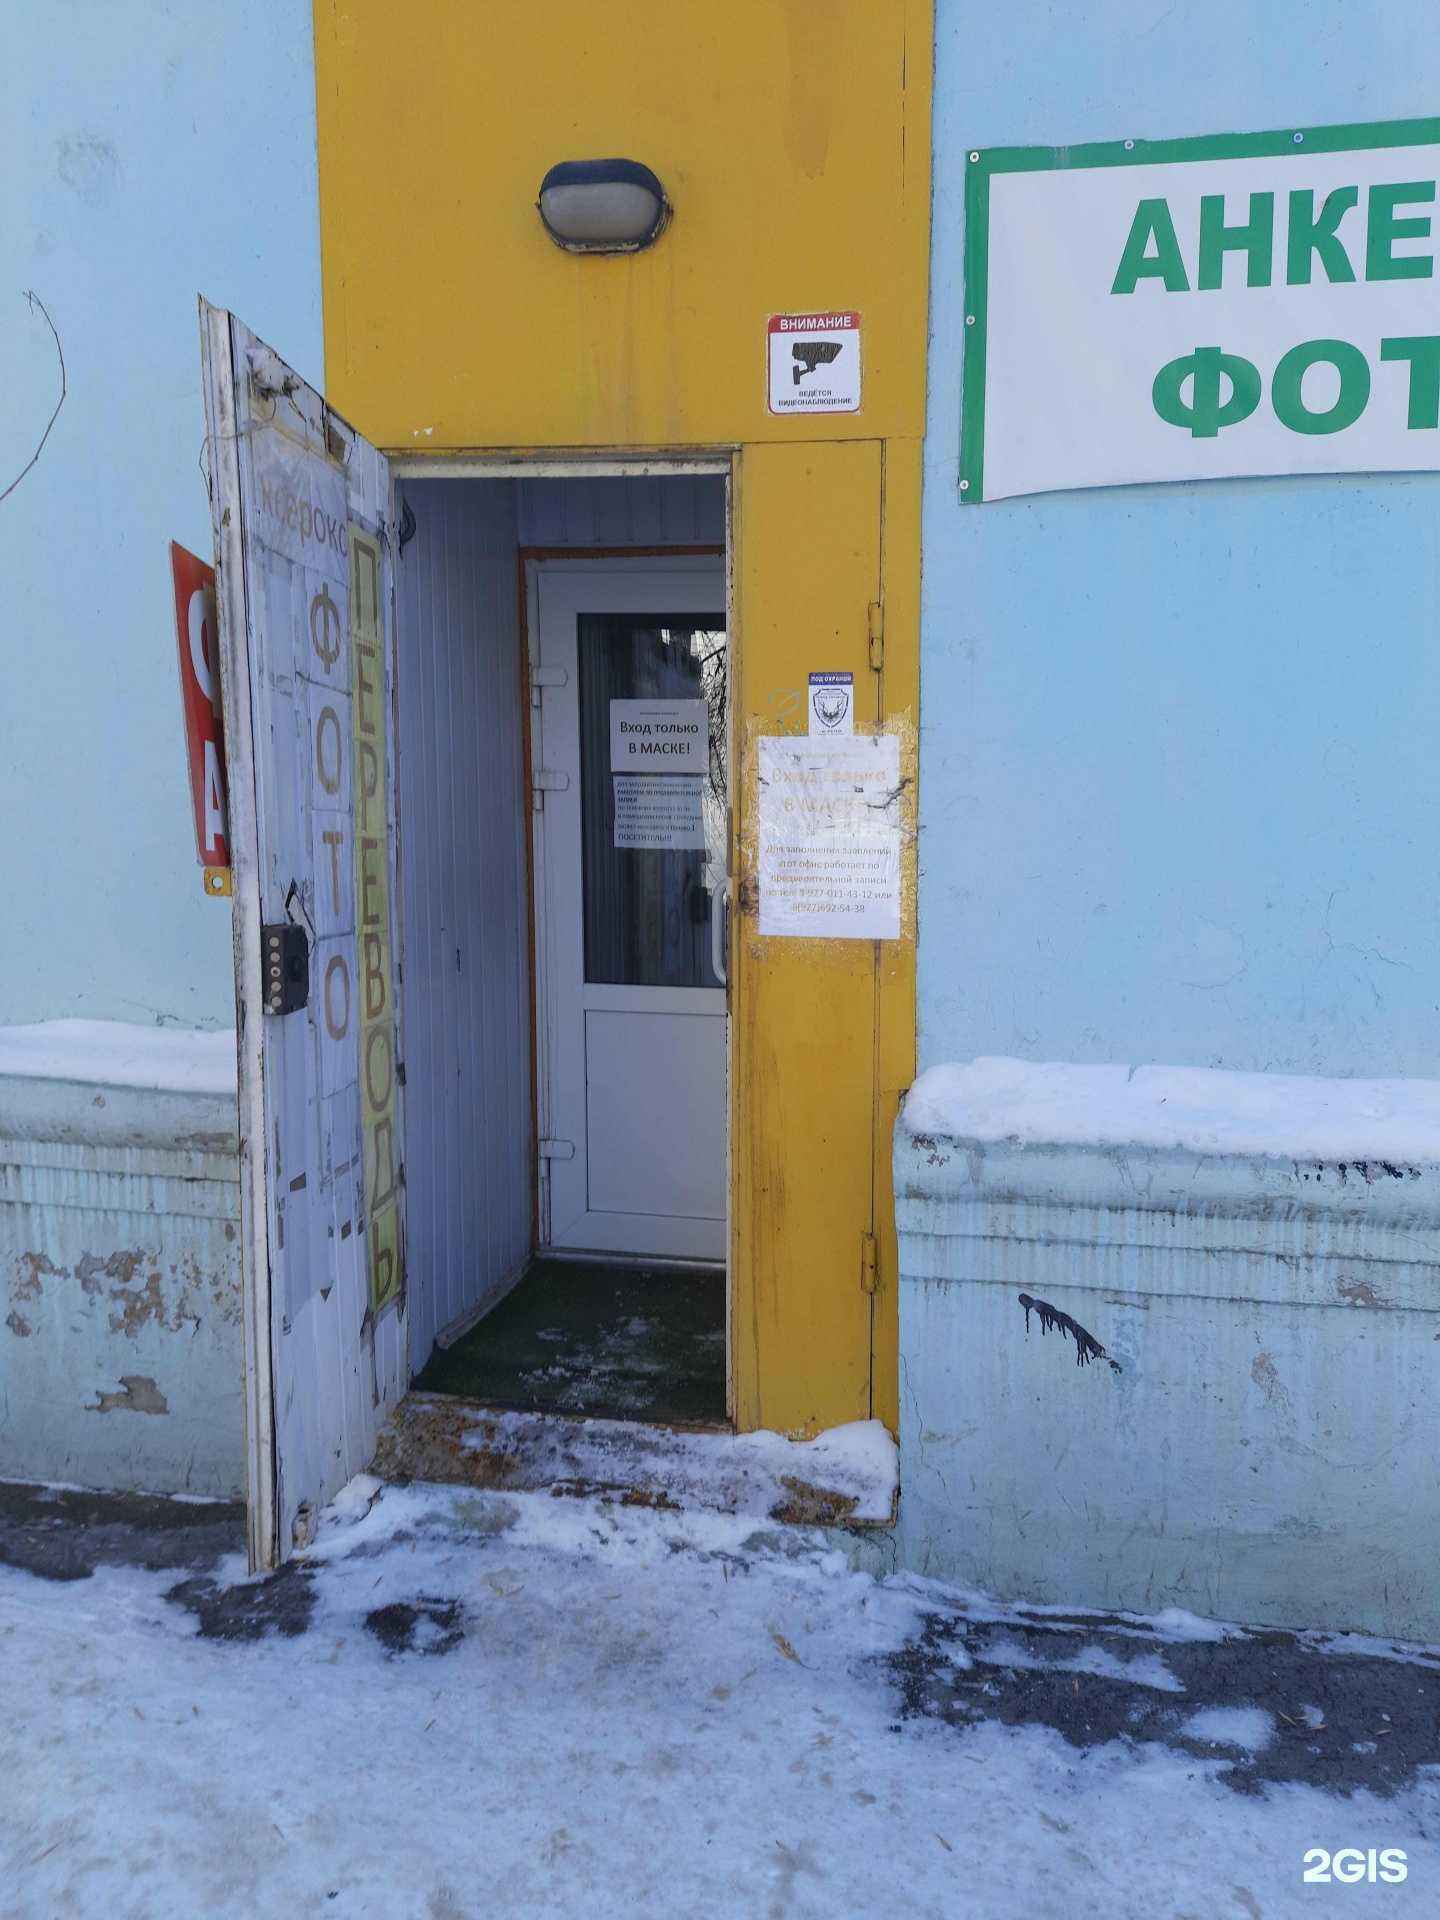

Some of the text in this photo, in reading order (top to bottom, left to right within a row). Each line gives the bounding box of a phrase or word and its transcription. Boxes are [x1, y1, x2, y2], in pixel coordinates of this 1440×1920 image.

[1110, 180, 1436, 294] АНКЕ
[780, 316, 852, 330] ВНИМАНИЕ
[1152, 335, 1440, 438] ФОТ
[778, 398, 852, 407] ВИДЕОНАБЛЮДЕНИЕ
[620, 721, 699, 736] Вход только
[629, 742, 691, 755] В МАСКЕ!
[310, 581, 350, 1042] ФОТО
